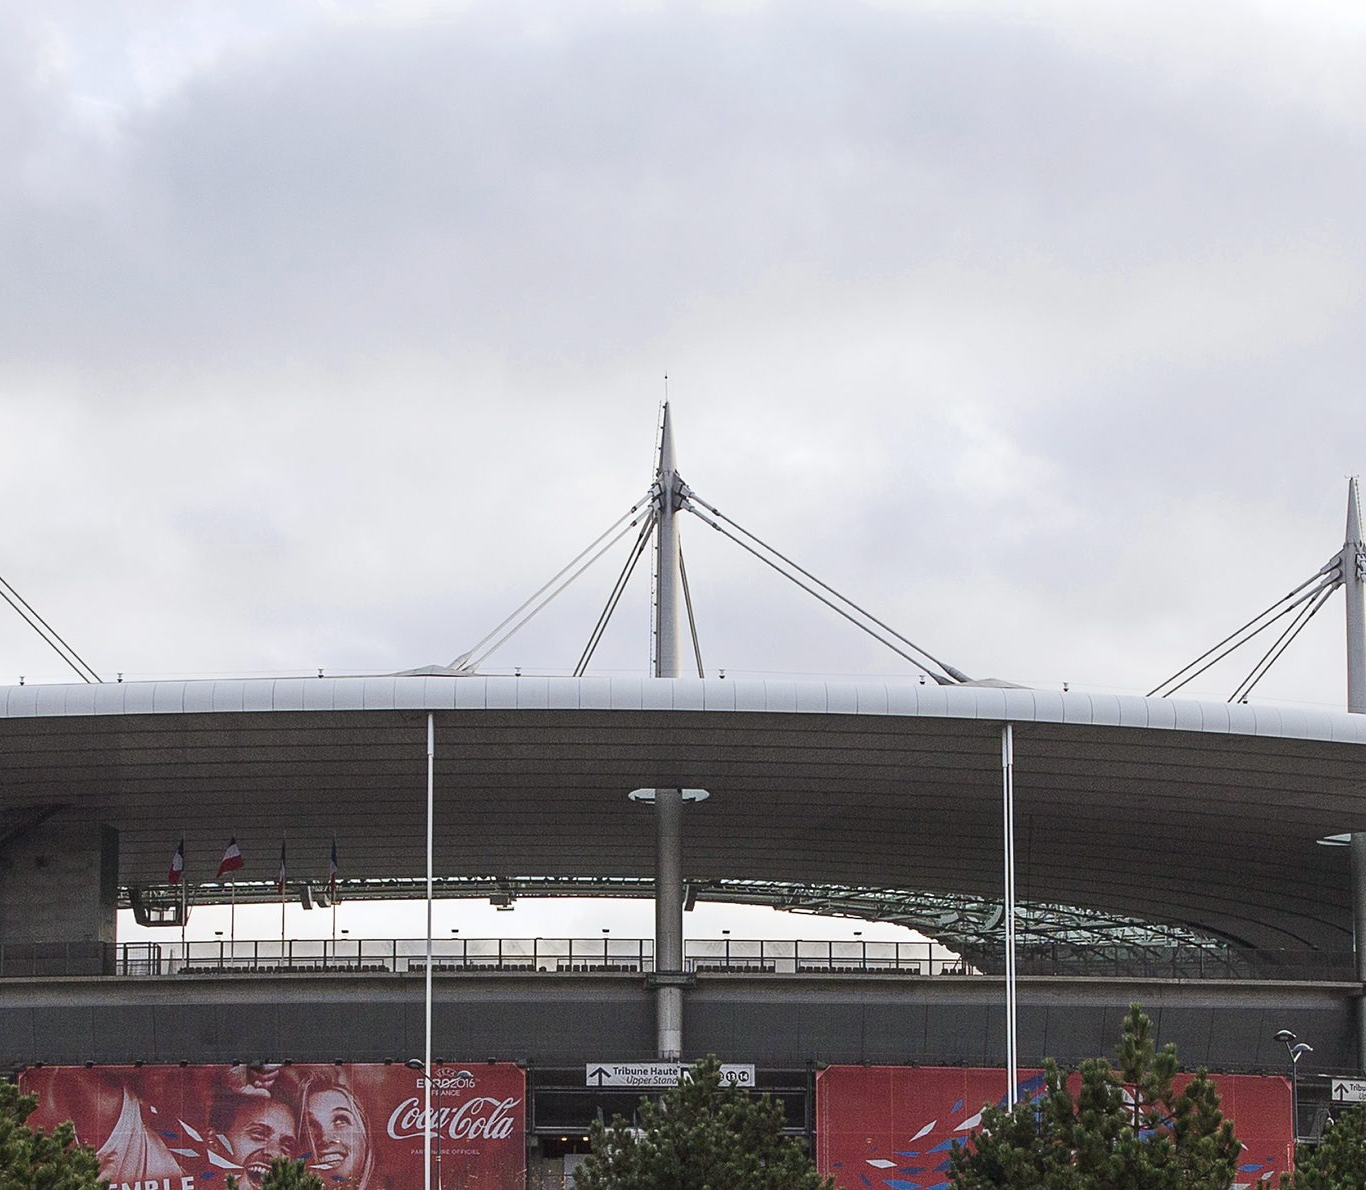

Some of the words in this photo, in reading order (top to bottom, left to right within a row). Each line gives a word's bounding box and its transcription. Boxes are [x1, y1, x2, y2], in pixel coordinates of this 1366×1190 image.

[613, 1065, 648, 1076] Tribune
[650, 1066, 678, 1076] Haute
[416, 1078, 475, 1089] ERO2016
[626, 1076, 651, 1085] Upper
[653, 1075, 678, 1085] Stand
[386, 1097, 522, 1140] Coca-Cola
